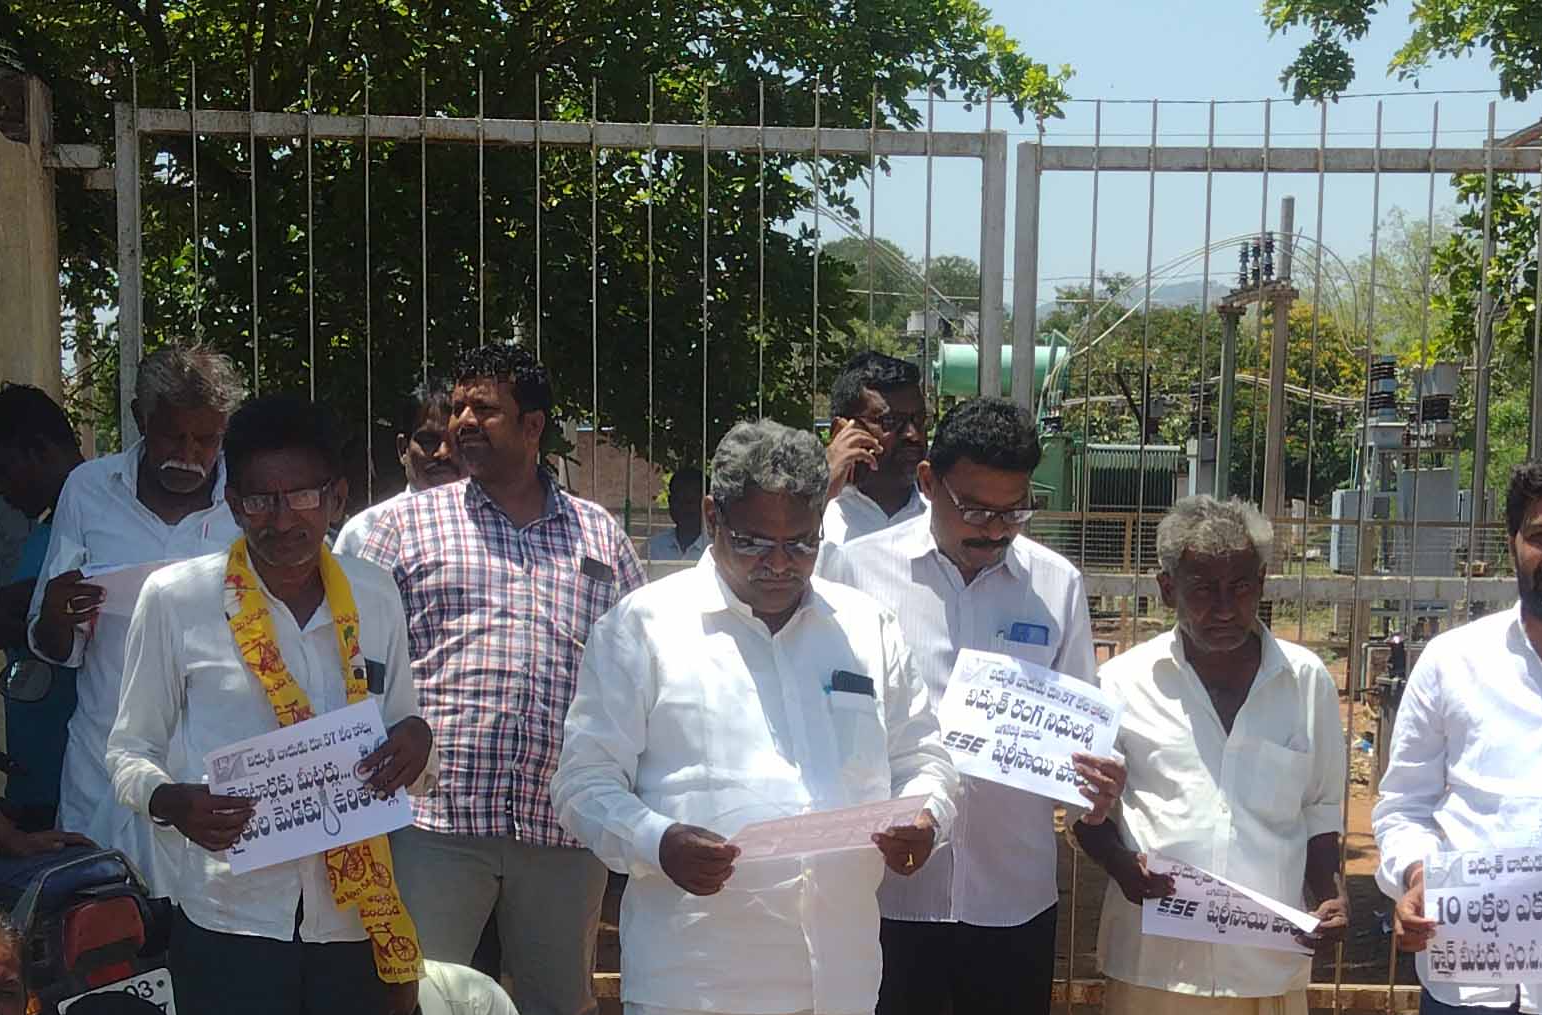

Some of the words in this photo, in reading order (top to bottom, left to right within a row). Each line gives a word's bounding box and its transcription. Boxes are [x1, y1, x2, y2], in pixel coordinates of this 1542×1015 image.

[943, 730, 989, 753] SSE
[1156, 896, 1200, 918] SSE
[1437, 896, 1461, 925] 10
[1466, 893, 1510, 938] లక్షల
